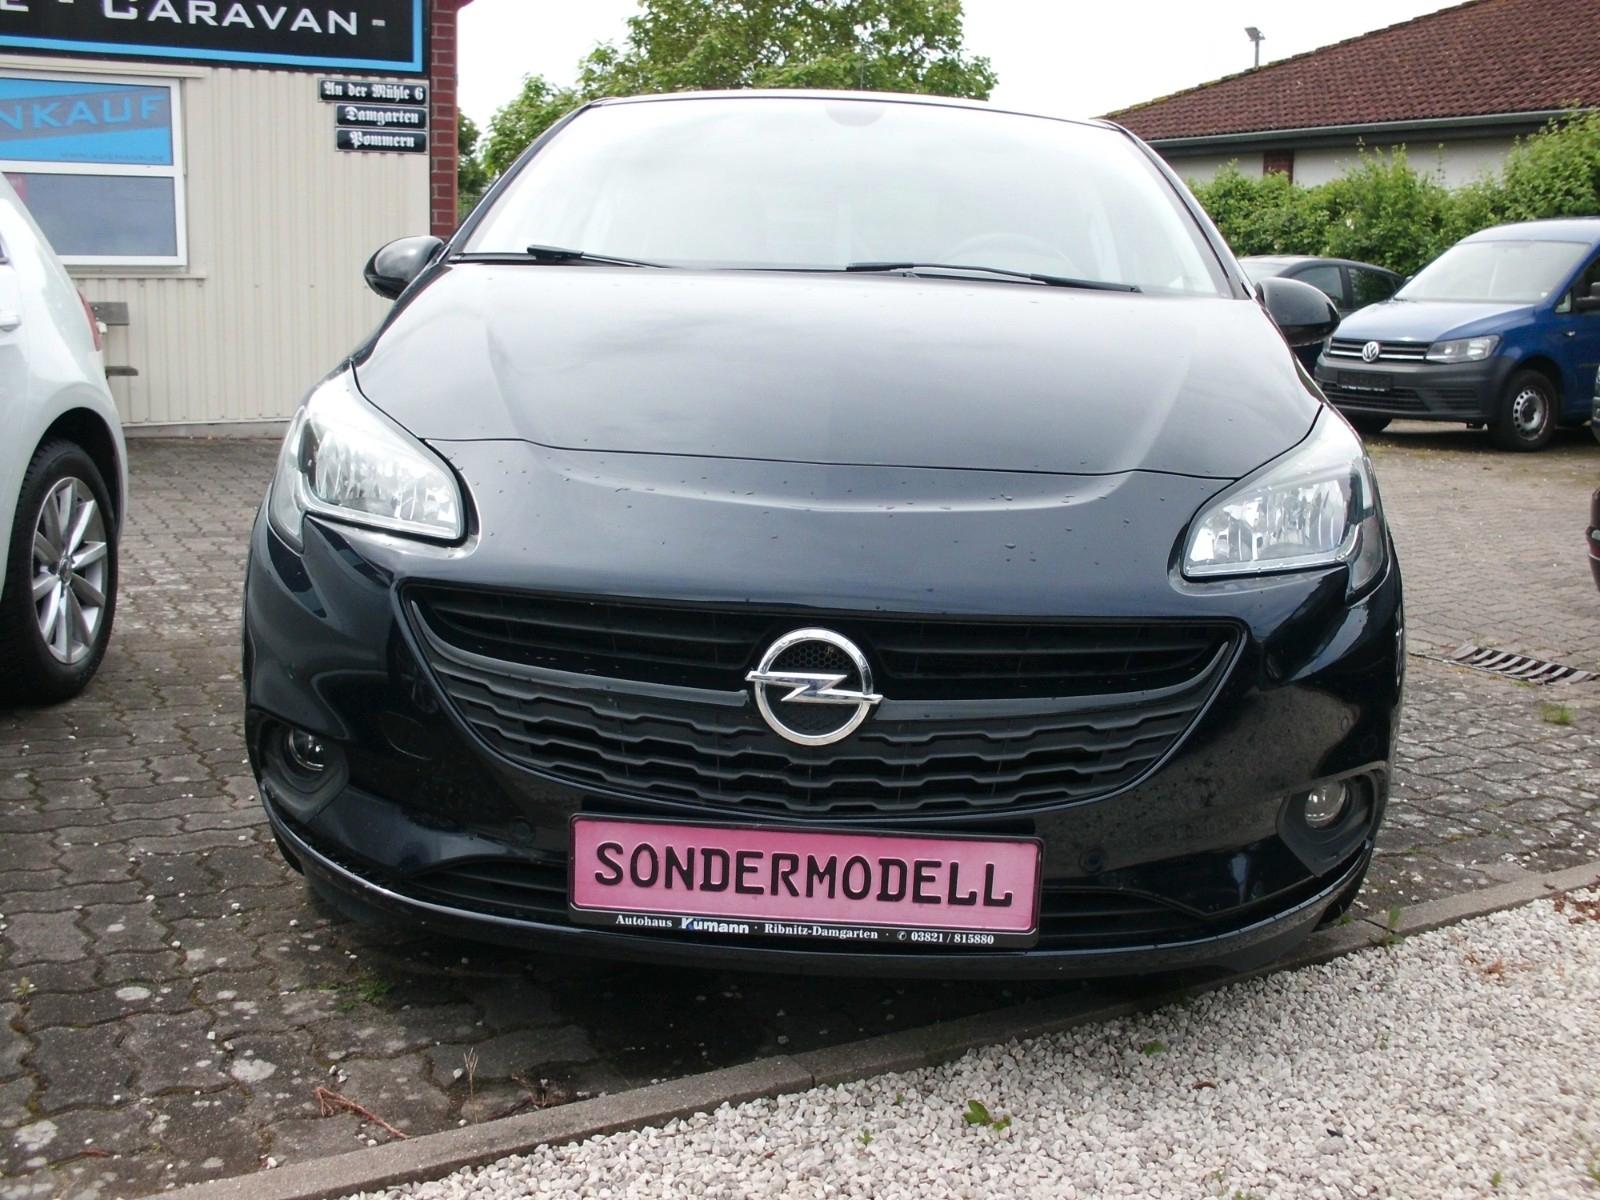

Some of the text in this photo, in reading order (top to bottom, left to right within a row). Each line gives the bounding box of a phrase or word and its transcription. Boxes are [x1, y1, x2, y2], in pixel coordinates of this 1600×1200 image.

[103, 0, 358, 36] CARAVAN
[323, 81, 425, 102] An der Mühle 6
[344, 106, 420, 126] Damgarten
[349, 131, 415, 149] Pommern
[594, 841, 1013, 907] SONDERMODELL
[615, 914, 673, 928] Autohaus
[764, 923, 879, 940] Ribnitz-Damgarten
[910, 931, 944, 943] 03821
[953, 934, 995, 945] 815880
